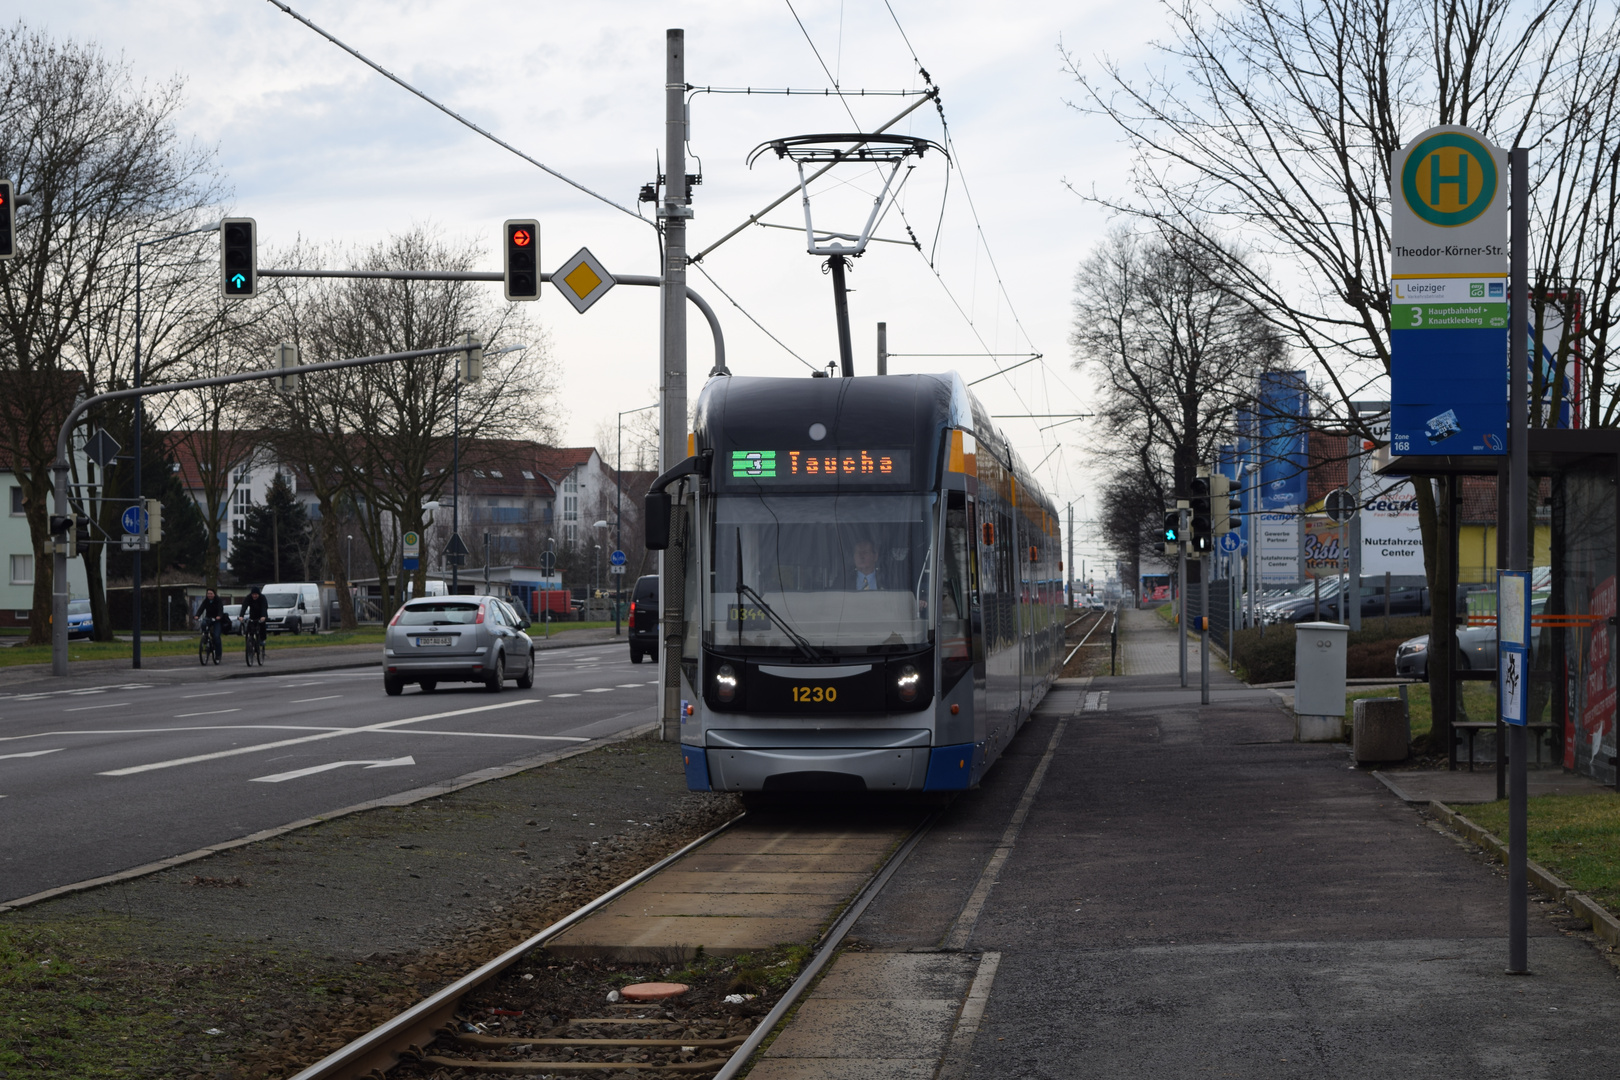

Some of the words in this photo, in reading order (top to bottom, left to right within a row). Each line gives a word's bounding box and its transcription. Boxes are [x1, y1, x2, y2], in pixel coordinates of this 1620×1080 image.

[1430, 153, 1468, 205] H
[1396, 245, 1503, 257] Theodor-Körner-Str.
[1407, 283, 1446, 293] Leipziger
[1428, 306, 1481, 316] Hauptbahnhof
[1411, 306, 1422, 327] 3
[1428, 315, 1483, 325] Knautkleeberg
[1394, 441, 1410, 451] 168
[746, 453, 762, 475] 3
[789, 450, 893, 474] Taucha
[1364, 500, 1419, 511] Gegne
[1364, 537, 1423, 546] Nutzfahrzeu
[1381, 548, 1416, 557] Center
[792, 686, 838, 702] 1230
